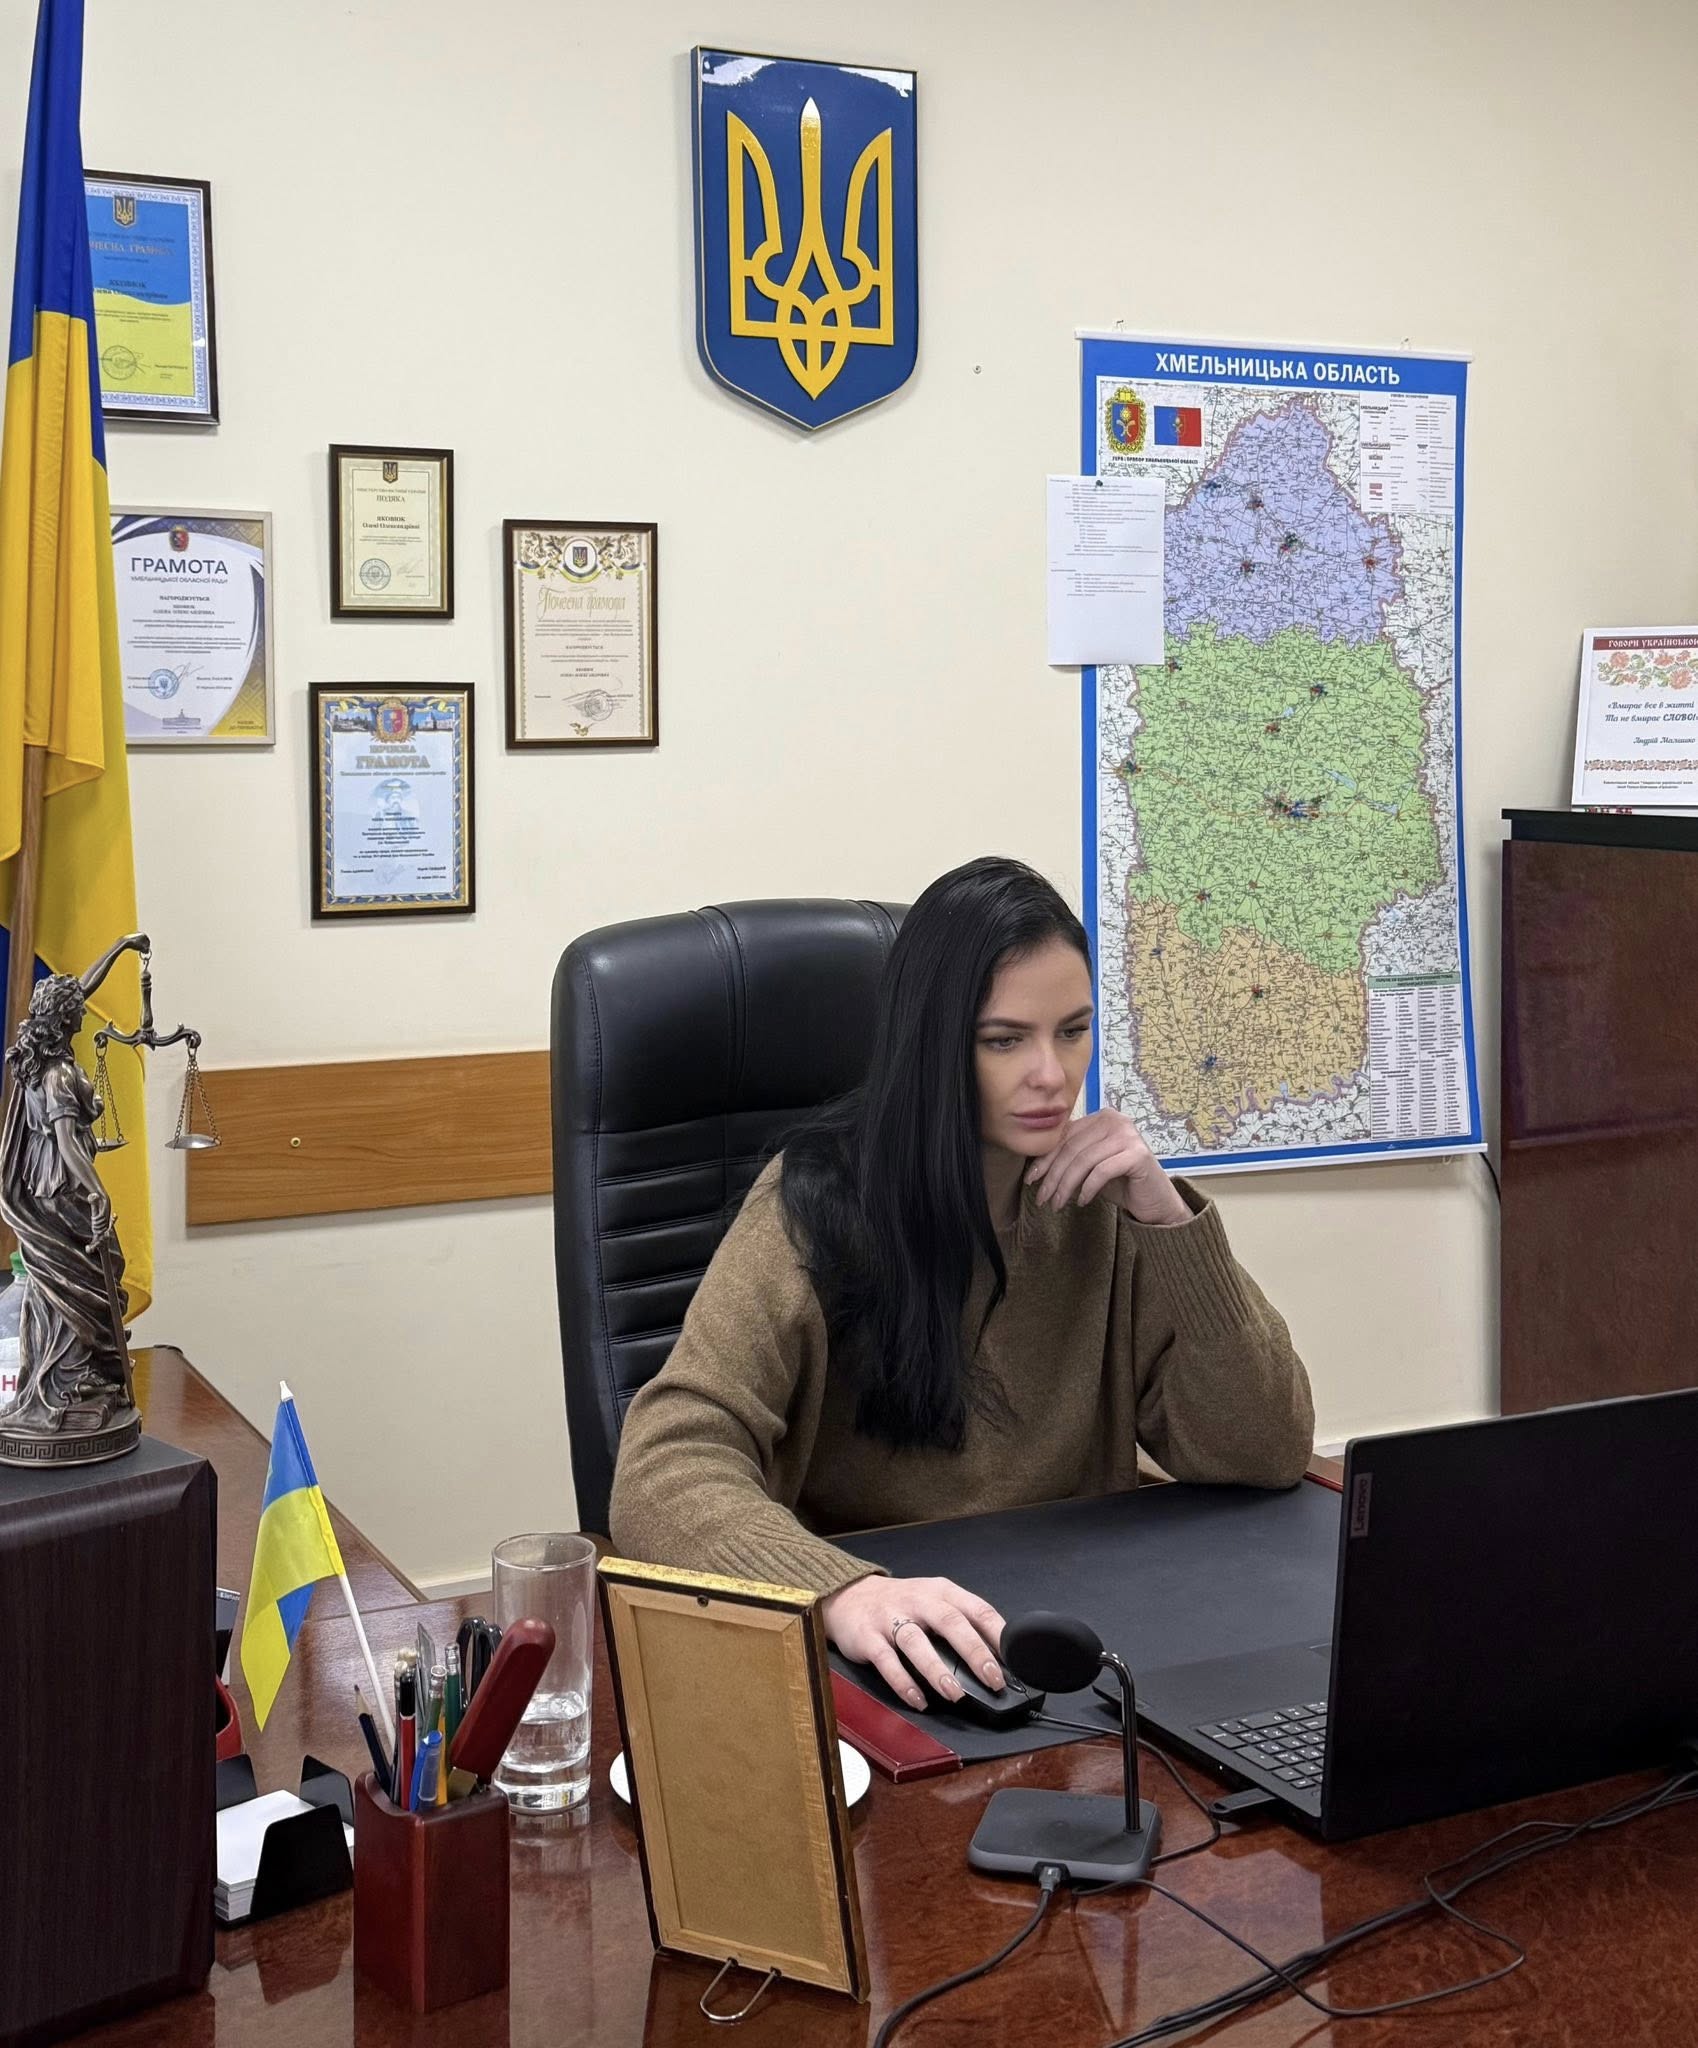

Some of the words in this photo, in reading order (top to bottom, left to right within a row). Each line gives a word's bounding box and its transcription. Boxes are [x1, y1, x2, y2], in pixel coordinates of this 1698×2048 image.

[1156, 352, 1308, 381] ХМЕЛЬНИЦЬКА
[1313, 362, 1400, 385] ОБЛАСТЬ
[131, 557, 228, 575] ГРАМОТА
[1608, 639, 1639, 648] ГОВОРИ
[1665, 701, 1695, 709] житті
[355, 755, 431, 769] ГРАМОТА
[1354, 1478, 1368, 1533] Lenovo
